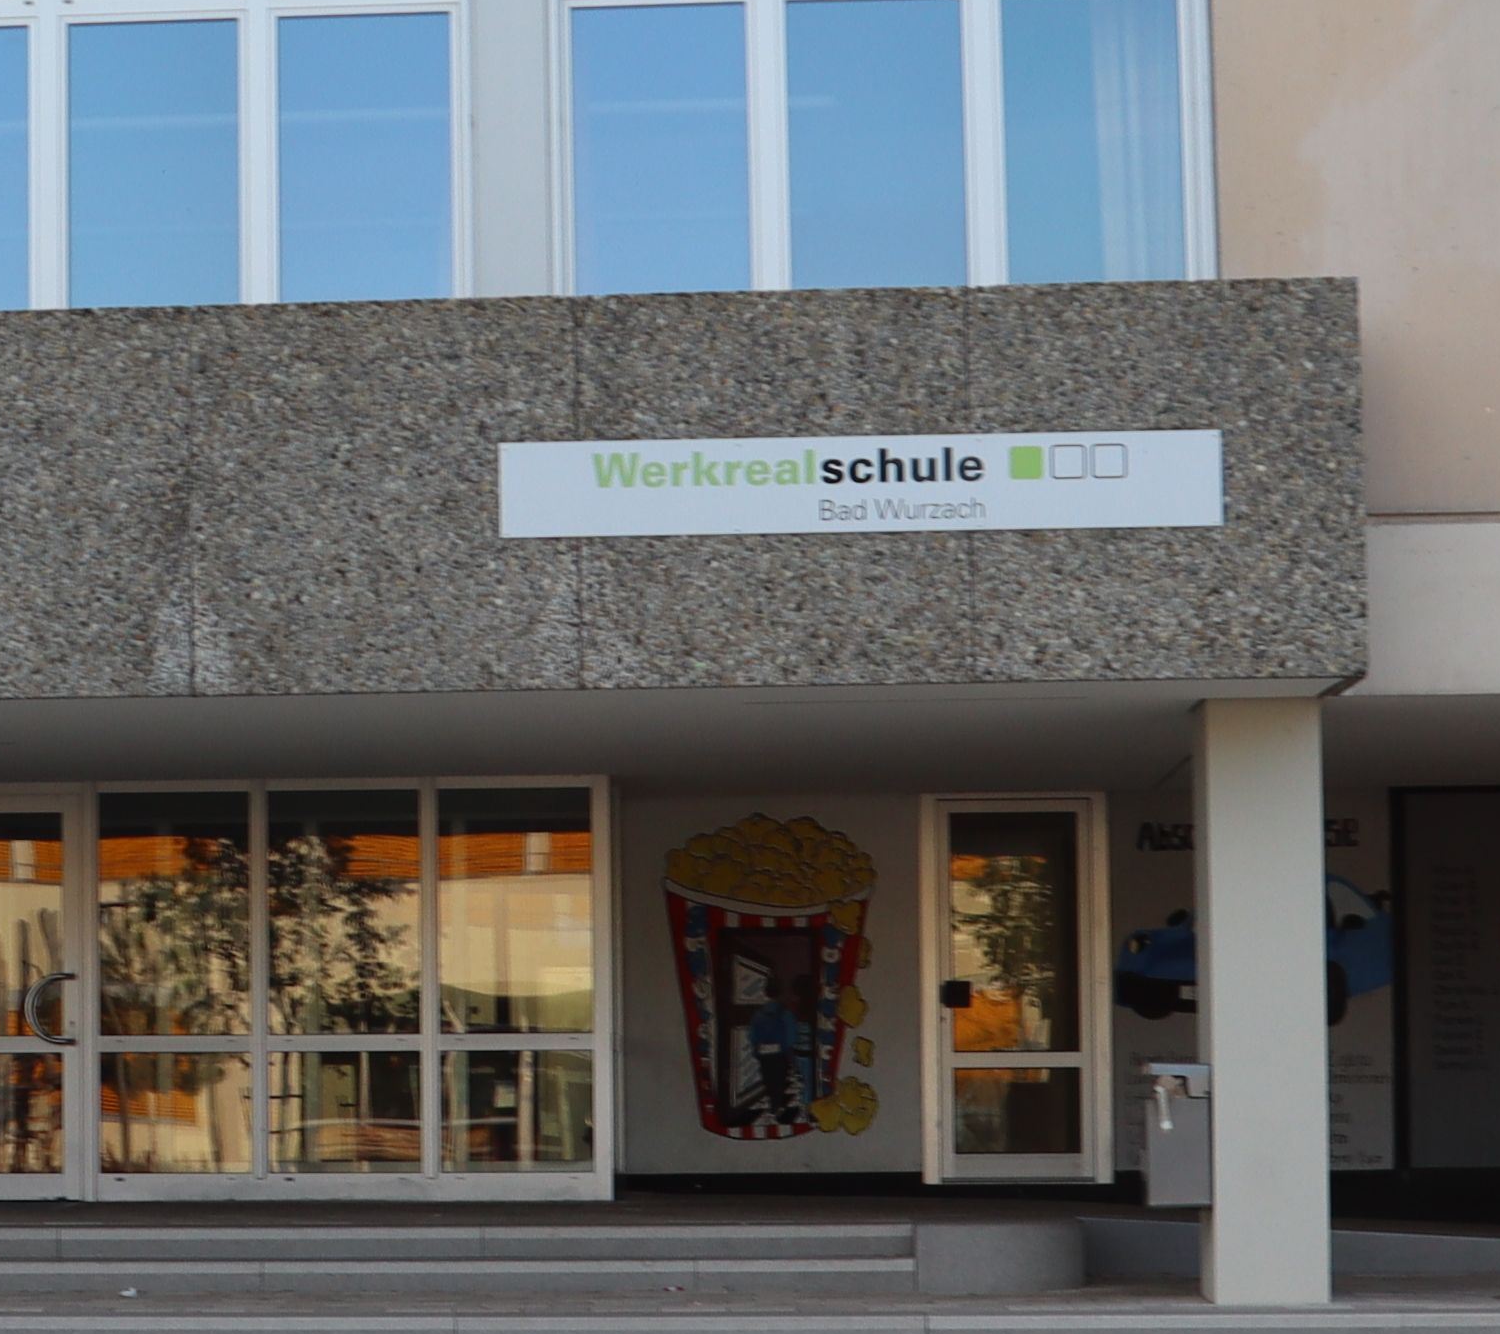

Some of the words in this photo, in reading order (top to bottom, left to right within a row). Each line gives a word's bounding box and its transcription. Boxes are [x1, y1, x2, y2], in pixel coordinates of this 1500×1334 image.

[592, 447, 984, 489] Werkrealschule
[818, 499, 867, 521] Bad
[873, 497, 987, 520] Wurzach
